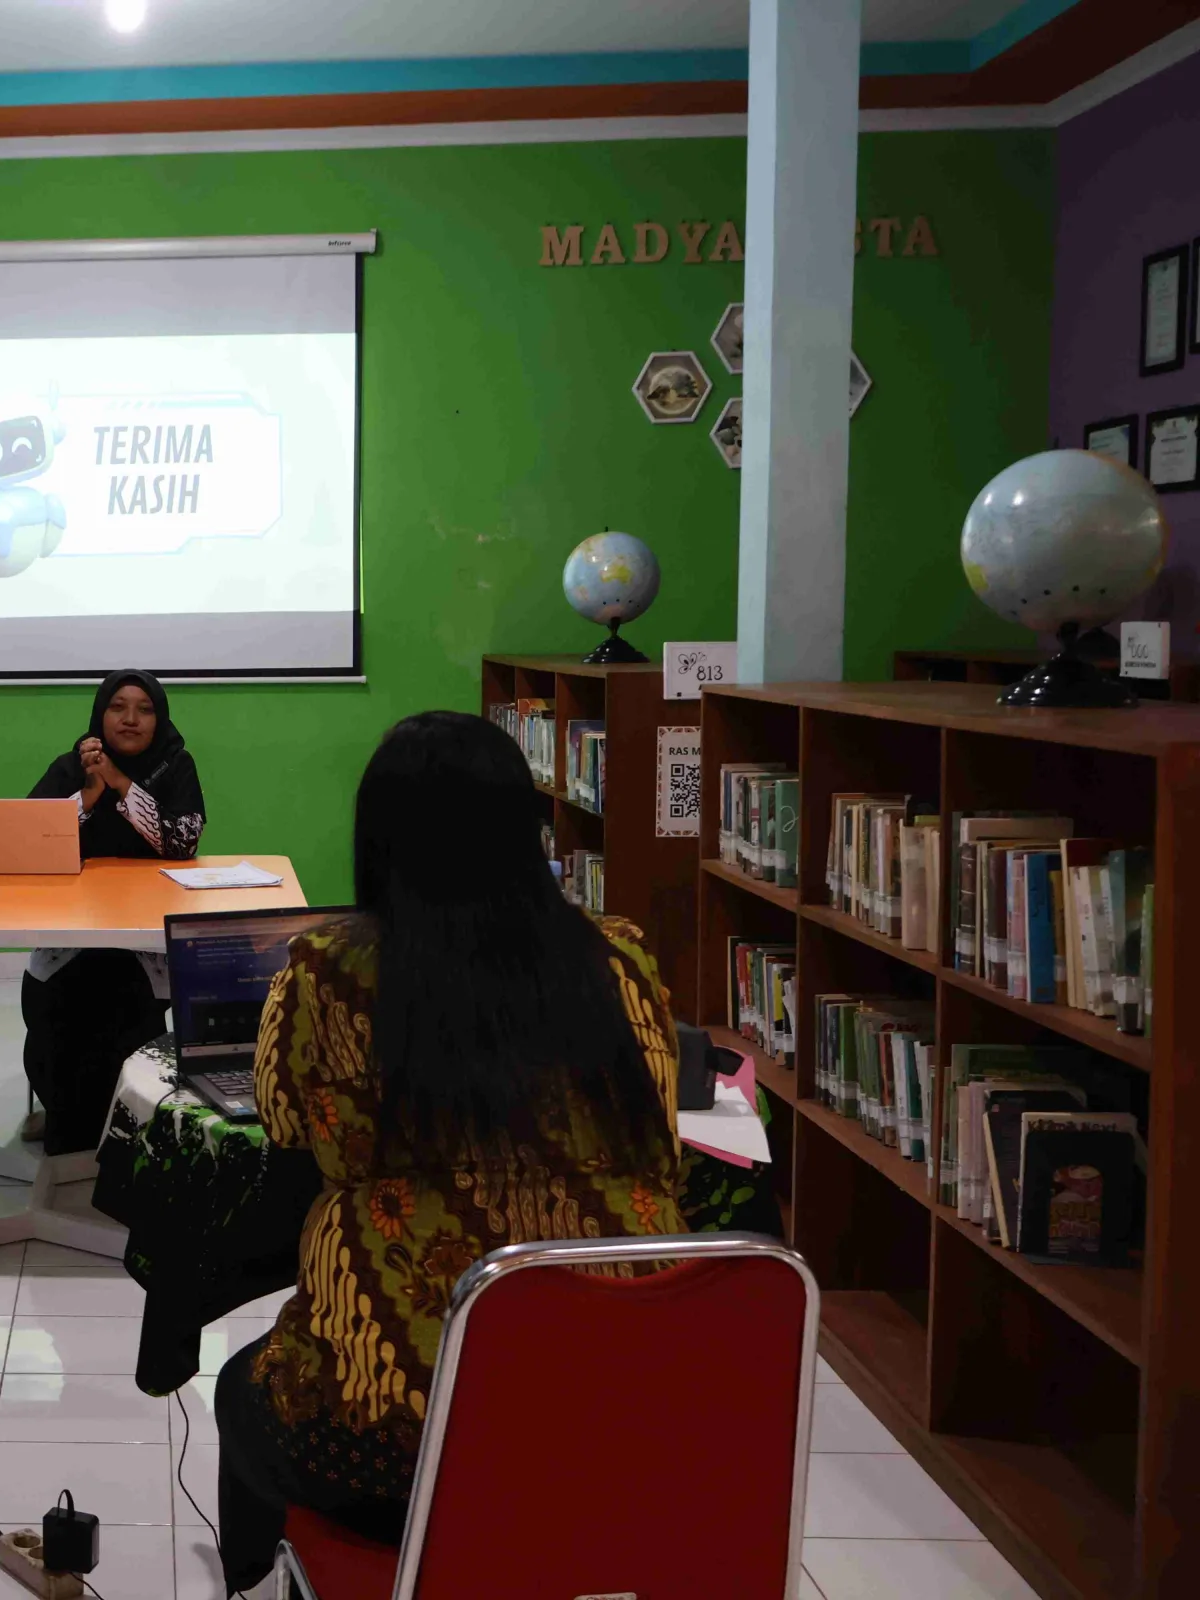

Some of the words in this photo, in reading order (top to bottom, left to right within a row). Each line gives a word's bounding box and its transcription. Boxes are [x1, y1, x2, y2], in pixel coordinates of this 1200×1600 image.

[93, 424, 214, 465] TERIMA
[107, 474, 201, 515] KASIH
[696, 665, 724, 681] 813
[669, 747, 688, 756] RAS
